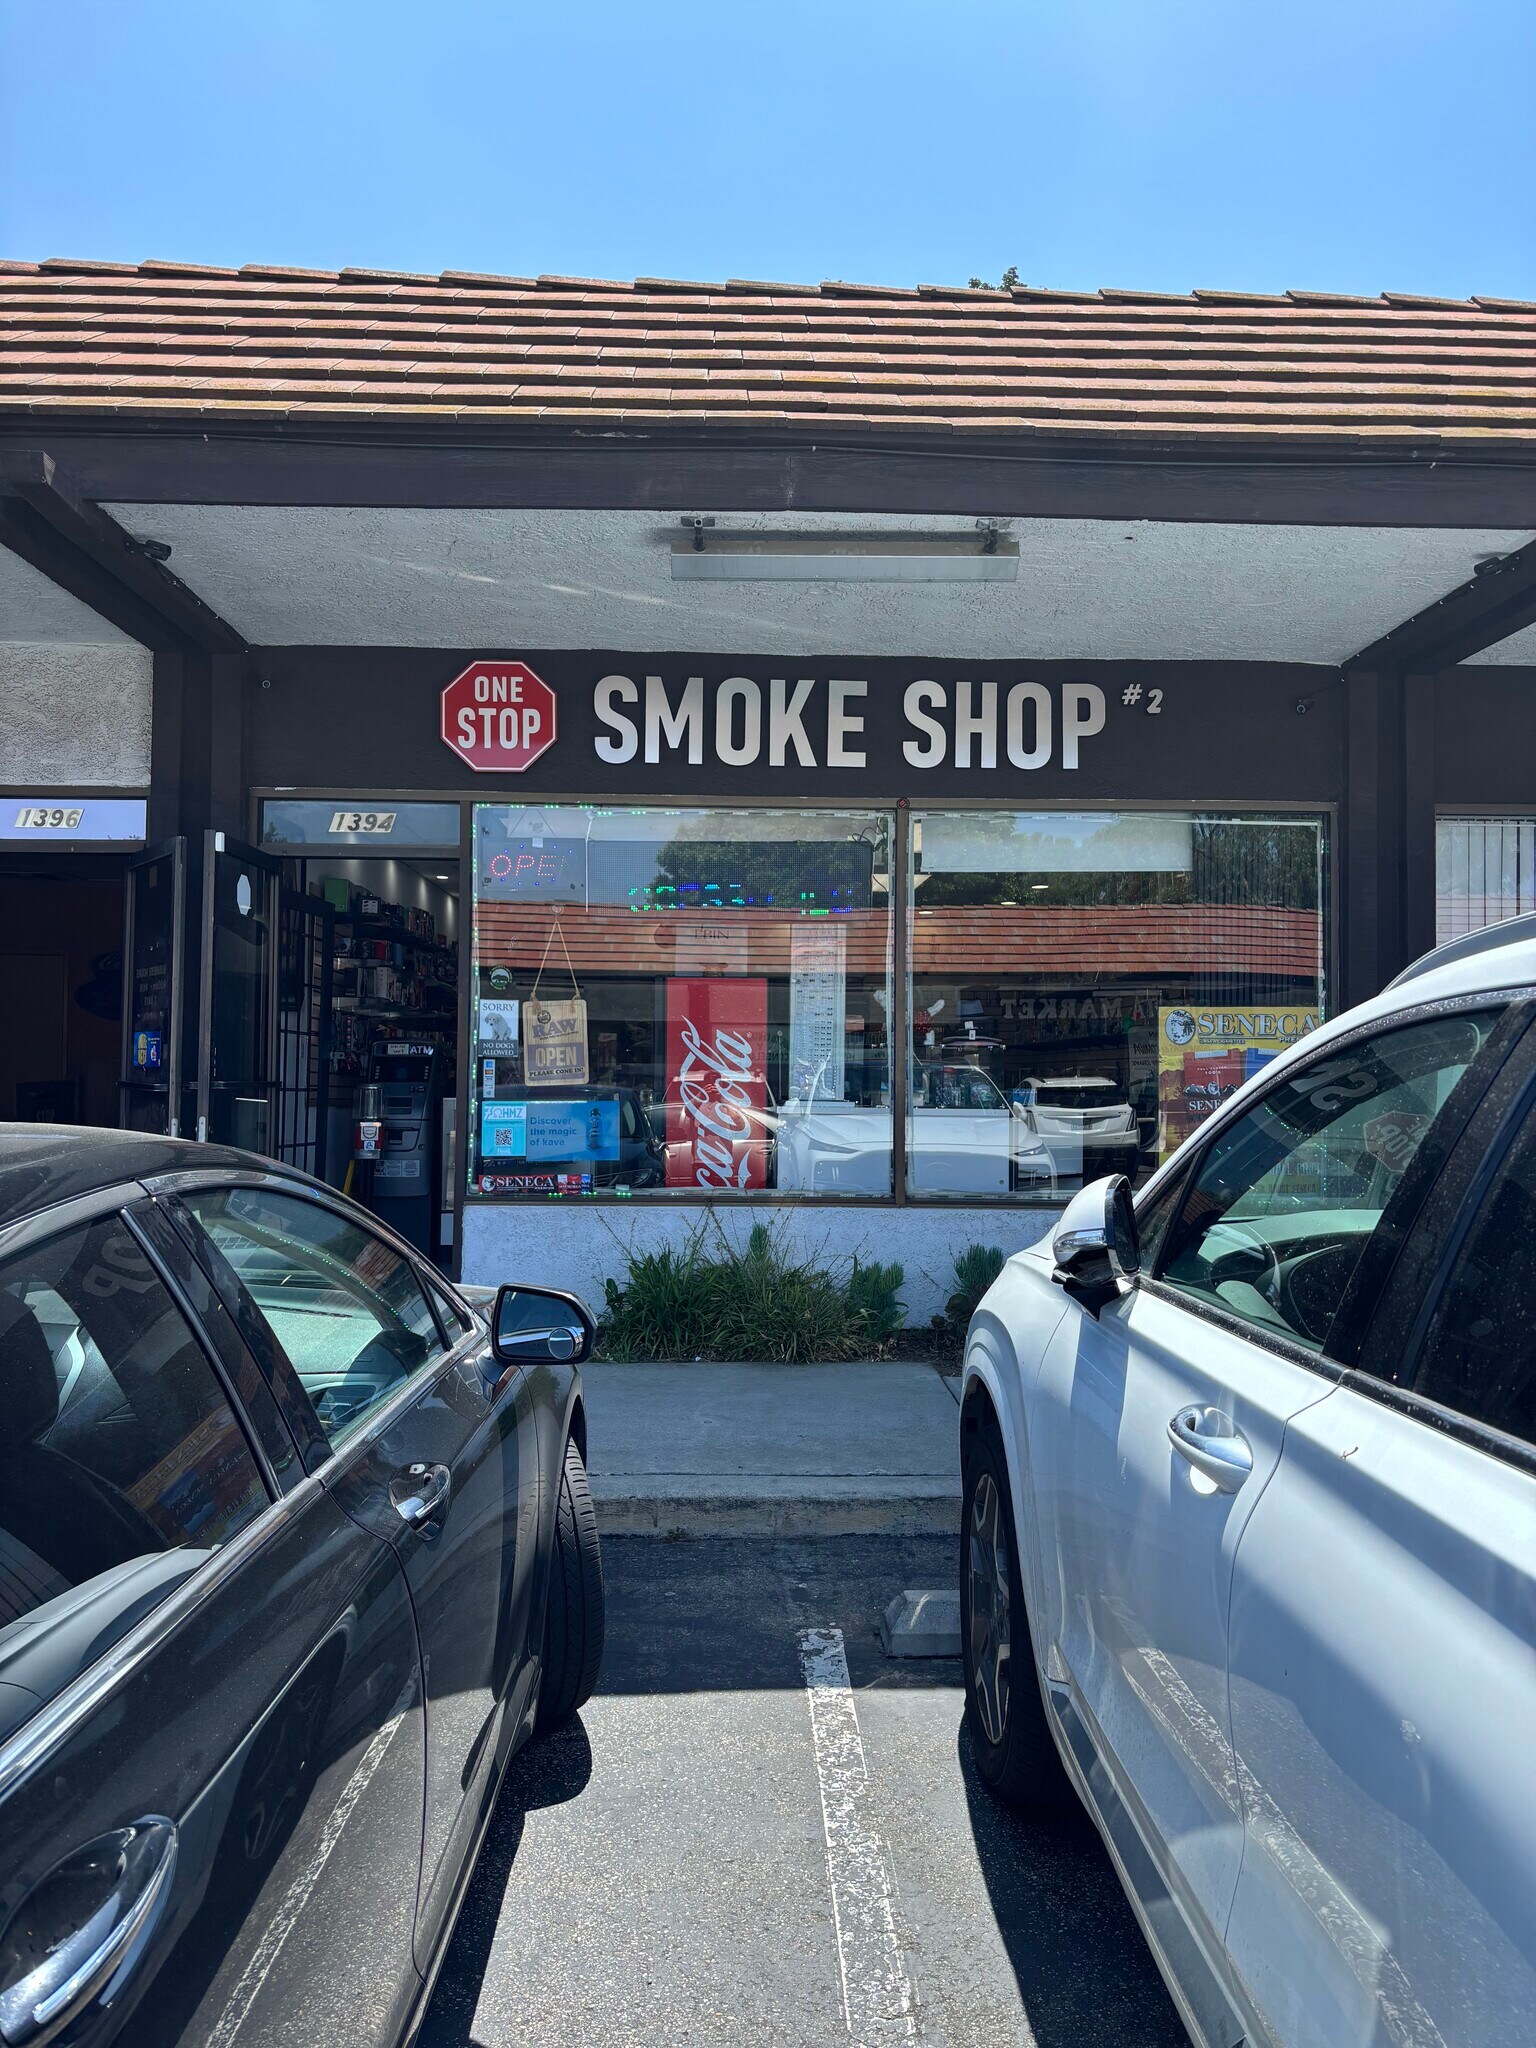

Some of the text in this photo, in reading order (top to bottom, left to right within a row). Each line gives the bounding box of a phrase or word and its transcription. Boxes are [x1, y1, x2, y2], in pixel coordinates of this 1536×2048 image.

[474, 675, 524, 703] ONE
[457, 706, 541, 750] STOP
[593, 674, 868, 768] SMOKE
[902, 679, 1106, 770] SHOP
[22, 808, 80, 828] 1396
[334, 813, 394, 831] 1394
[482, 1002, 515, 1012] SORRY
[532, 1018, 578, 1039] RAW
[1197, 1013, 1318, 1036] SENECA
[410, 1045, 433, 1055] ATM
[535, 1046, 577, 1068] OPEN
[529, 1069, 555, 1077] PLEASE
[555, 1067, 574, 1075] CONE
[530, 1116, 571, 1125] Discover
[530, 1127, 577, 1136] the magic
[530, 1138, 565, 1146] of kava
[496, 1176, 555, 1187] SENECA
